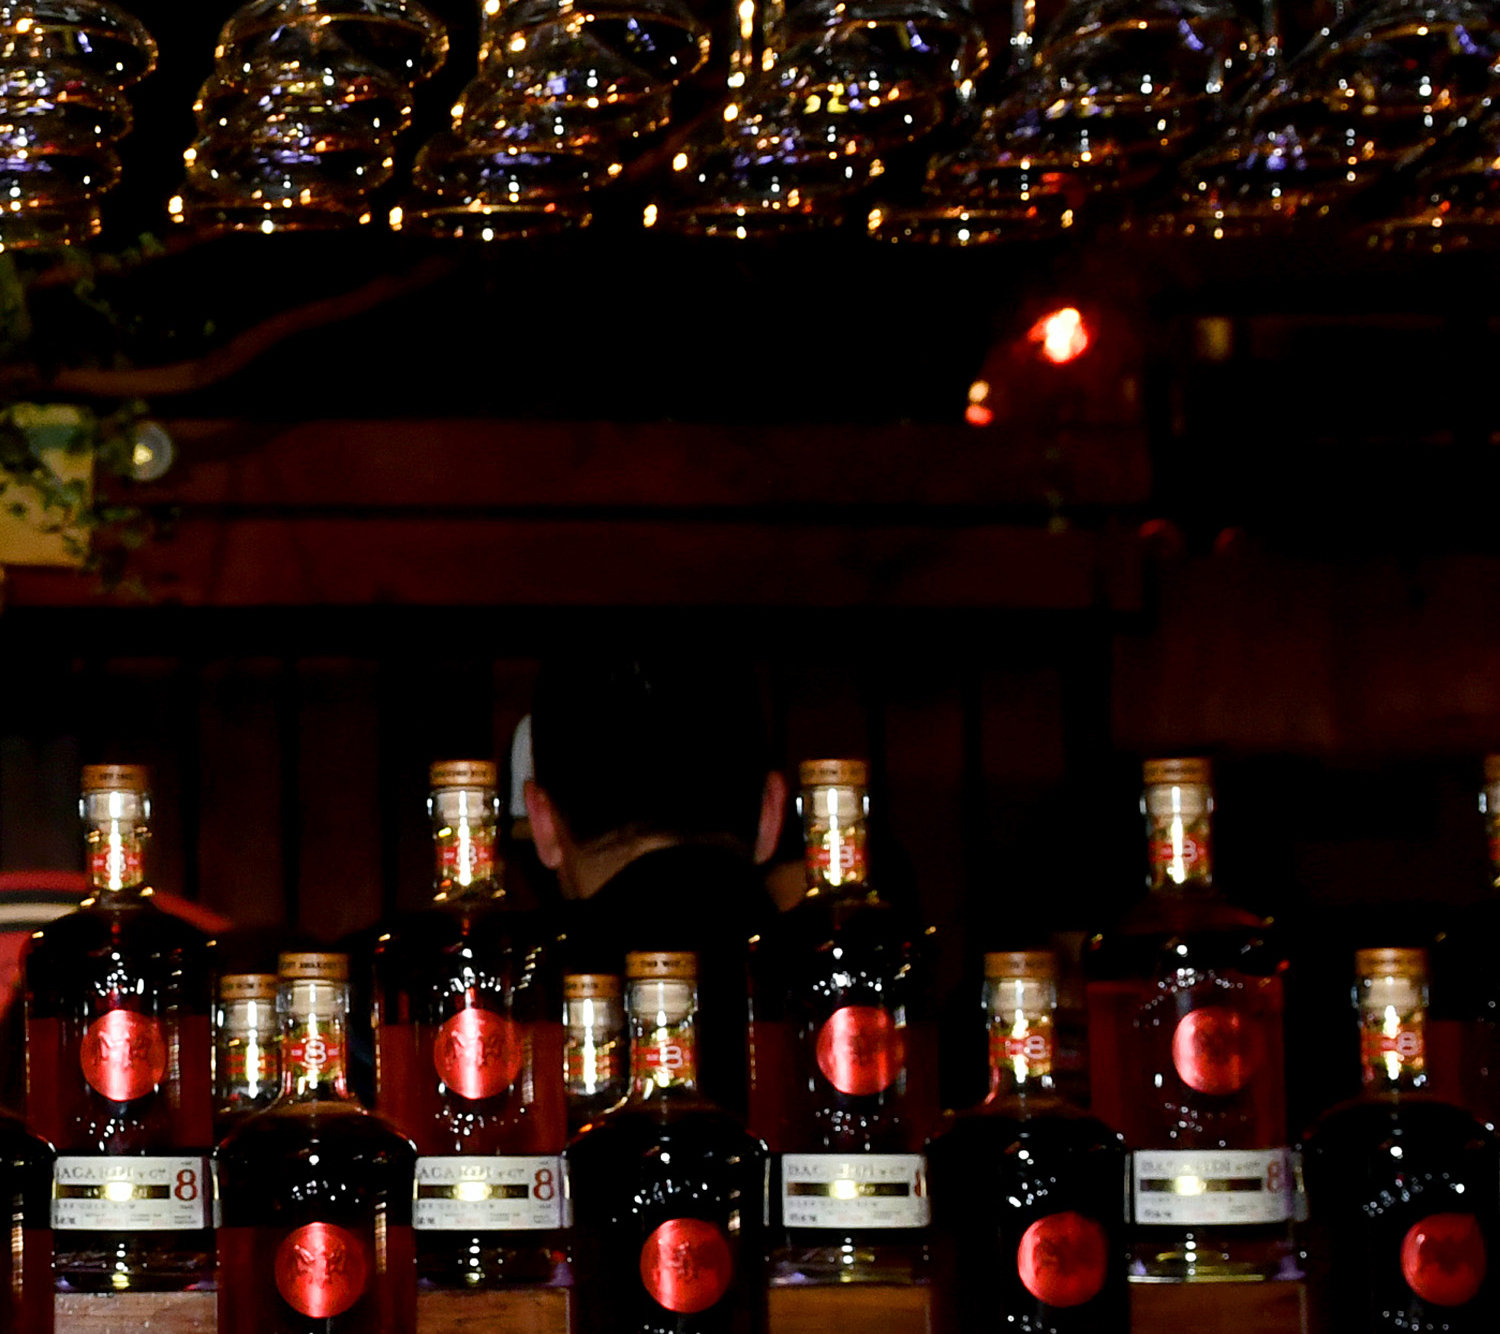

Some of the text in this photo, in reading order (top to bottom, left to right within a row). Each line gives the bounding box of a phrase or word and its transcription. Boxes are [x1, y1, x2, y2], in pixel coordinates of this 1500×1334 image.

[303, 1039, 328, 1064] 8
[658, 1044, 684, 1070] 8
[1025, 1035, 1048, 1060] 8
[1396, 1031, 1420, 1057] 8
[174, 1169, 198, 1201] 8
[532, 1168, 555, 1201] 8
